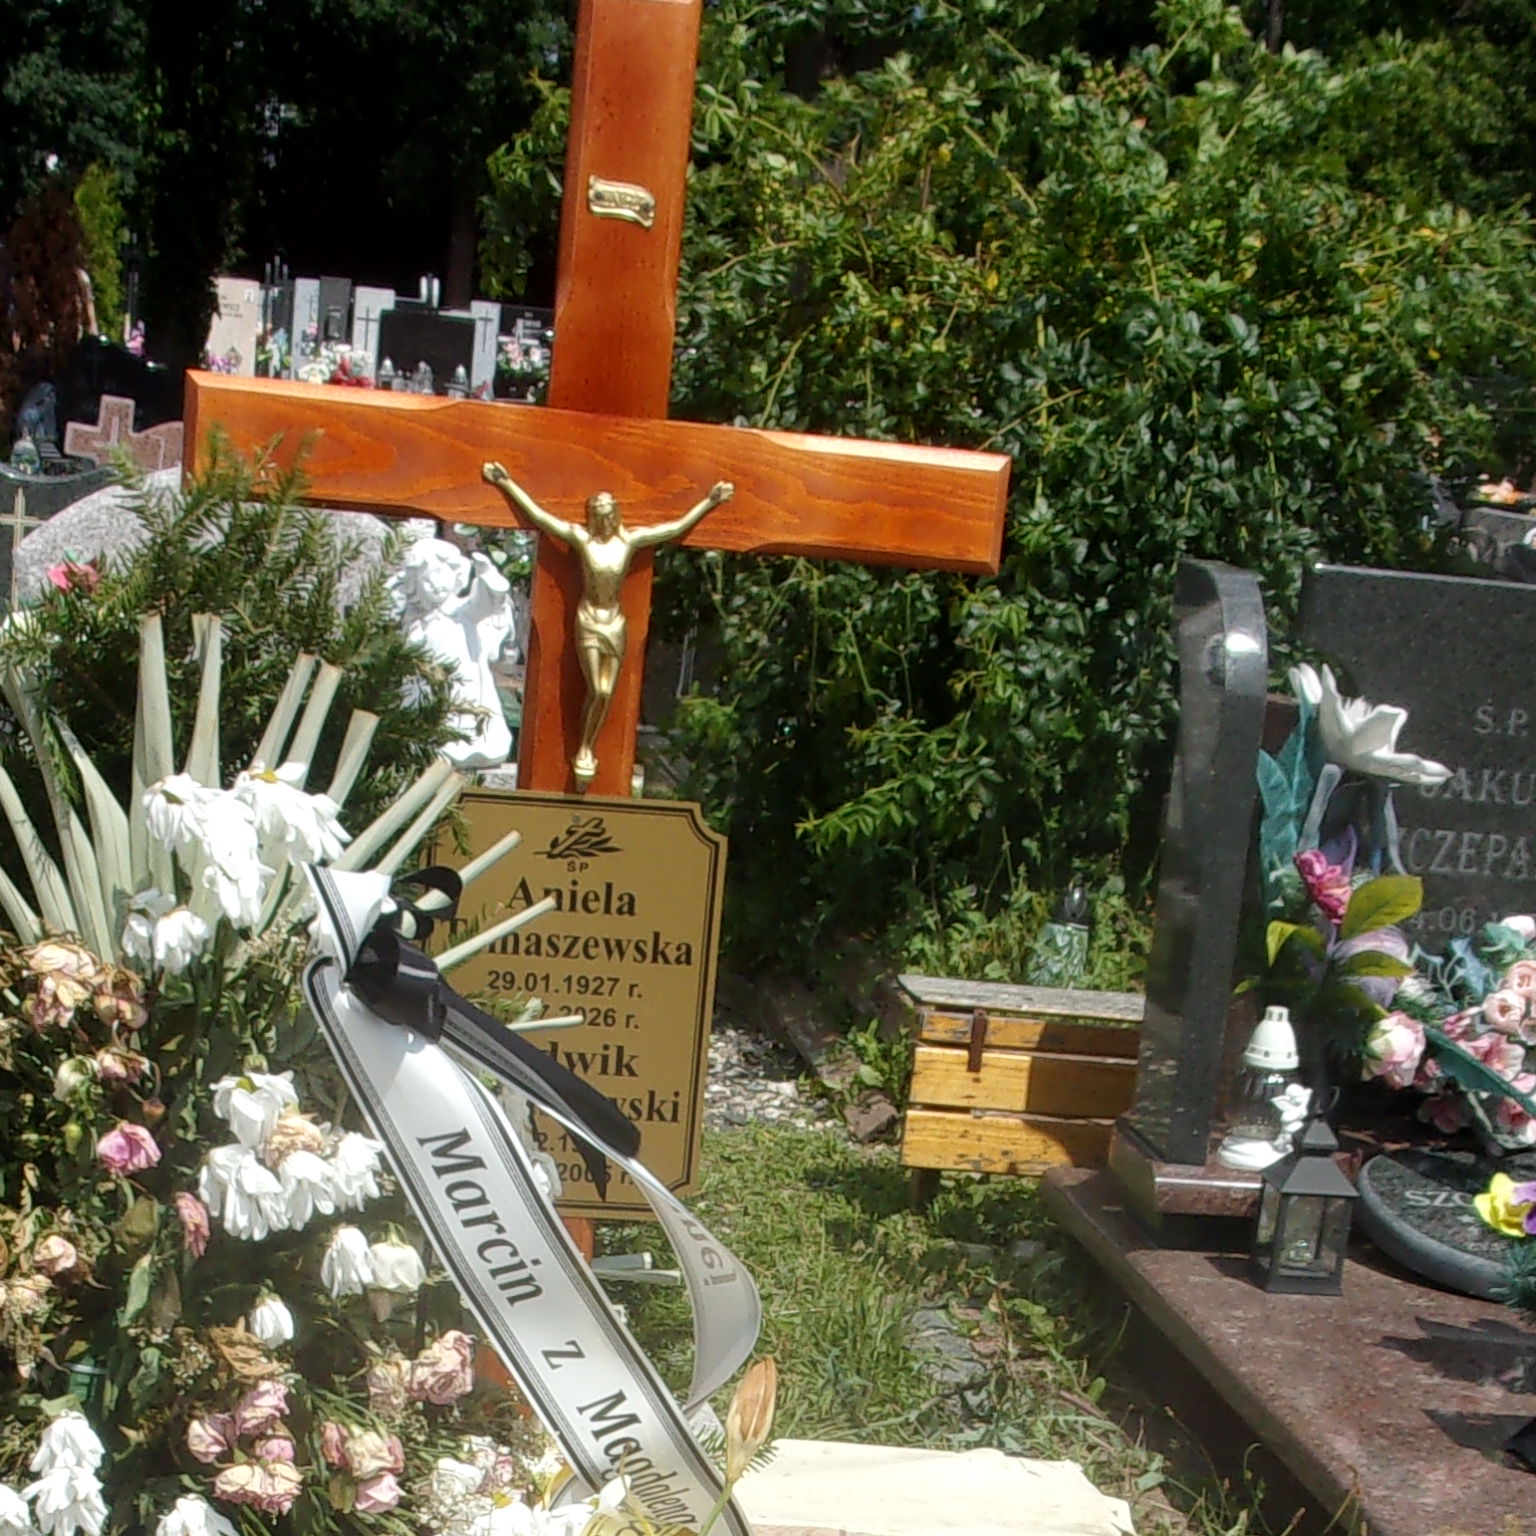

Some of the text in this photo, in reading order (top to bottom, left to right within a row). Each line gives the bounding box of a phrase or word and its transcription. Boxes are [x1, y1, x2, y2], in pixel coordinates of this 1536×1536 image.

[505, 875, 638, 917] Aniela
[441, 917, 694, 967] Tmaszewska
[487, 969, 643, 999] 29.01.1927 r.
[625, 1011, 640, 1030] r.
[416, 1127, 545, 1307] Marcin
[541, 1339, 586, 1371] z
